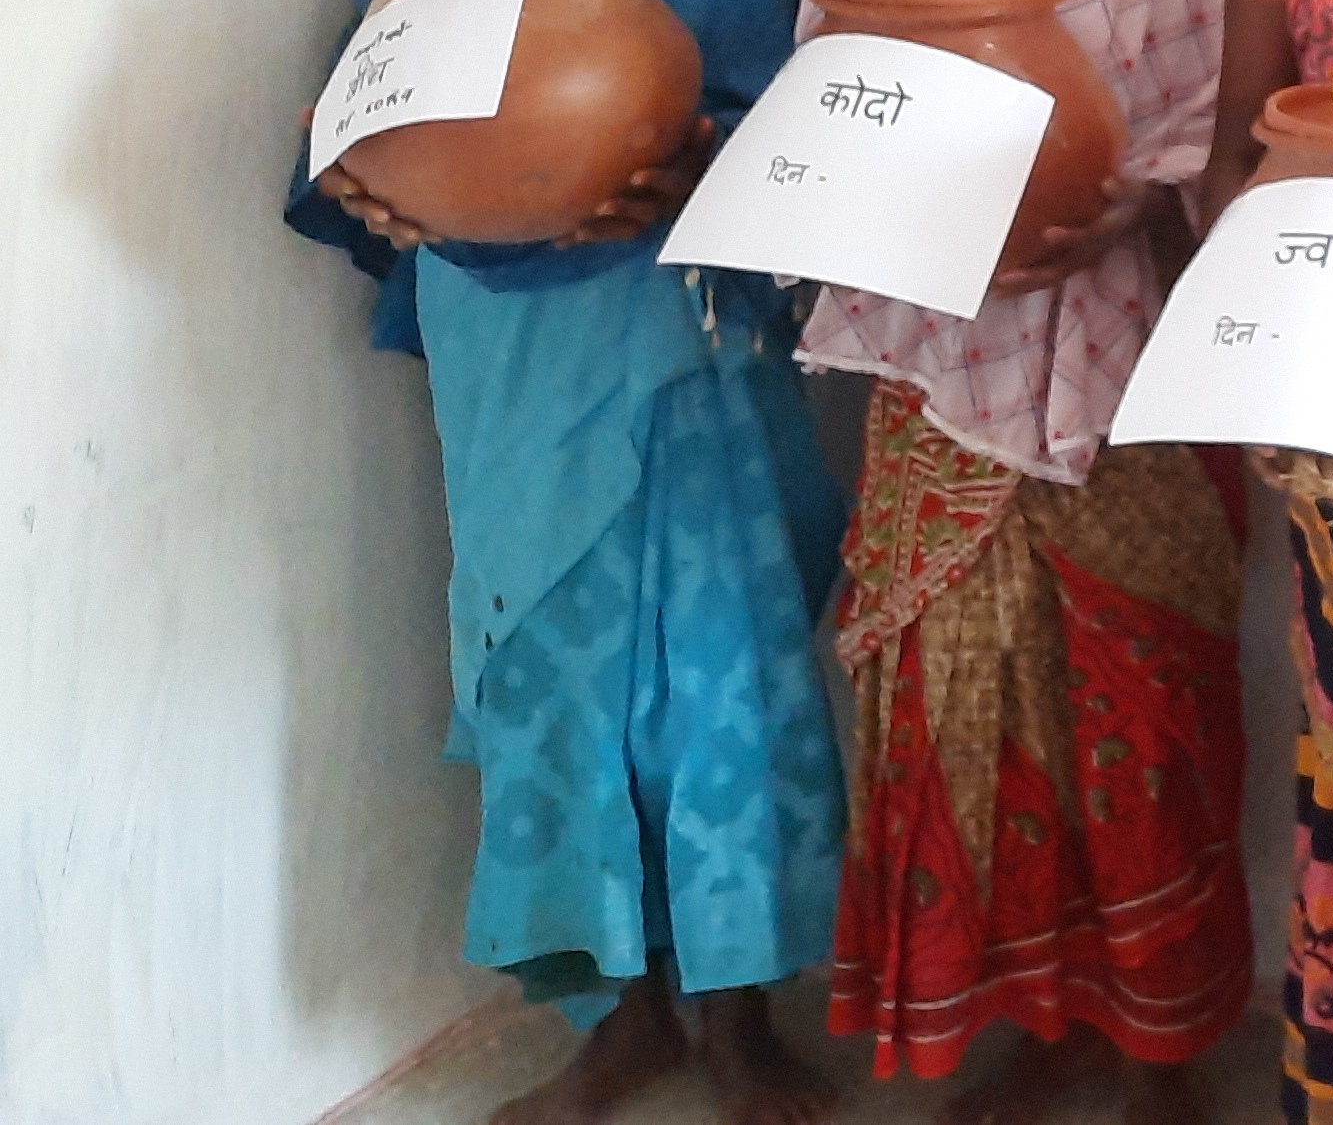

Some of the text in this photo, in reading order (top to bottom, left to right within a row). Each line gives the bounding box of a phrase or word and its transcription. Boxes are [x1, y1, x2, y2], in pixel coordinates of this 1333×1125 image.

[819, 74, 914, 128] कोदो
[766, 155, 811, 186] दिन
[1212, 315, 1261, 347] दिन
